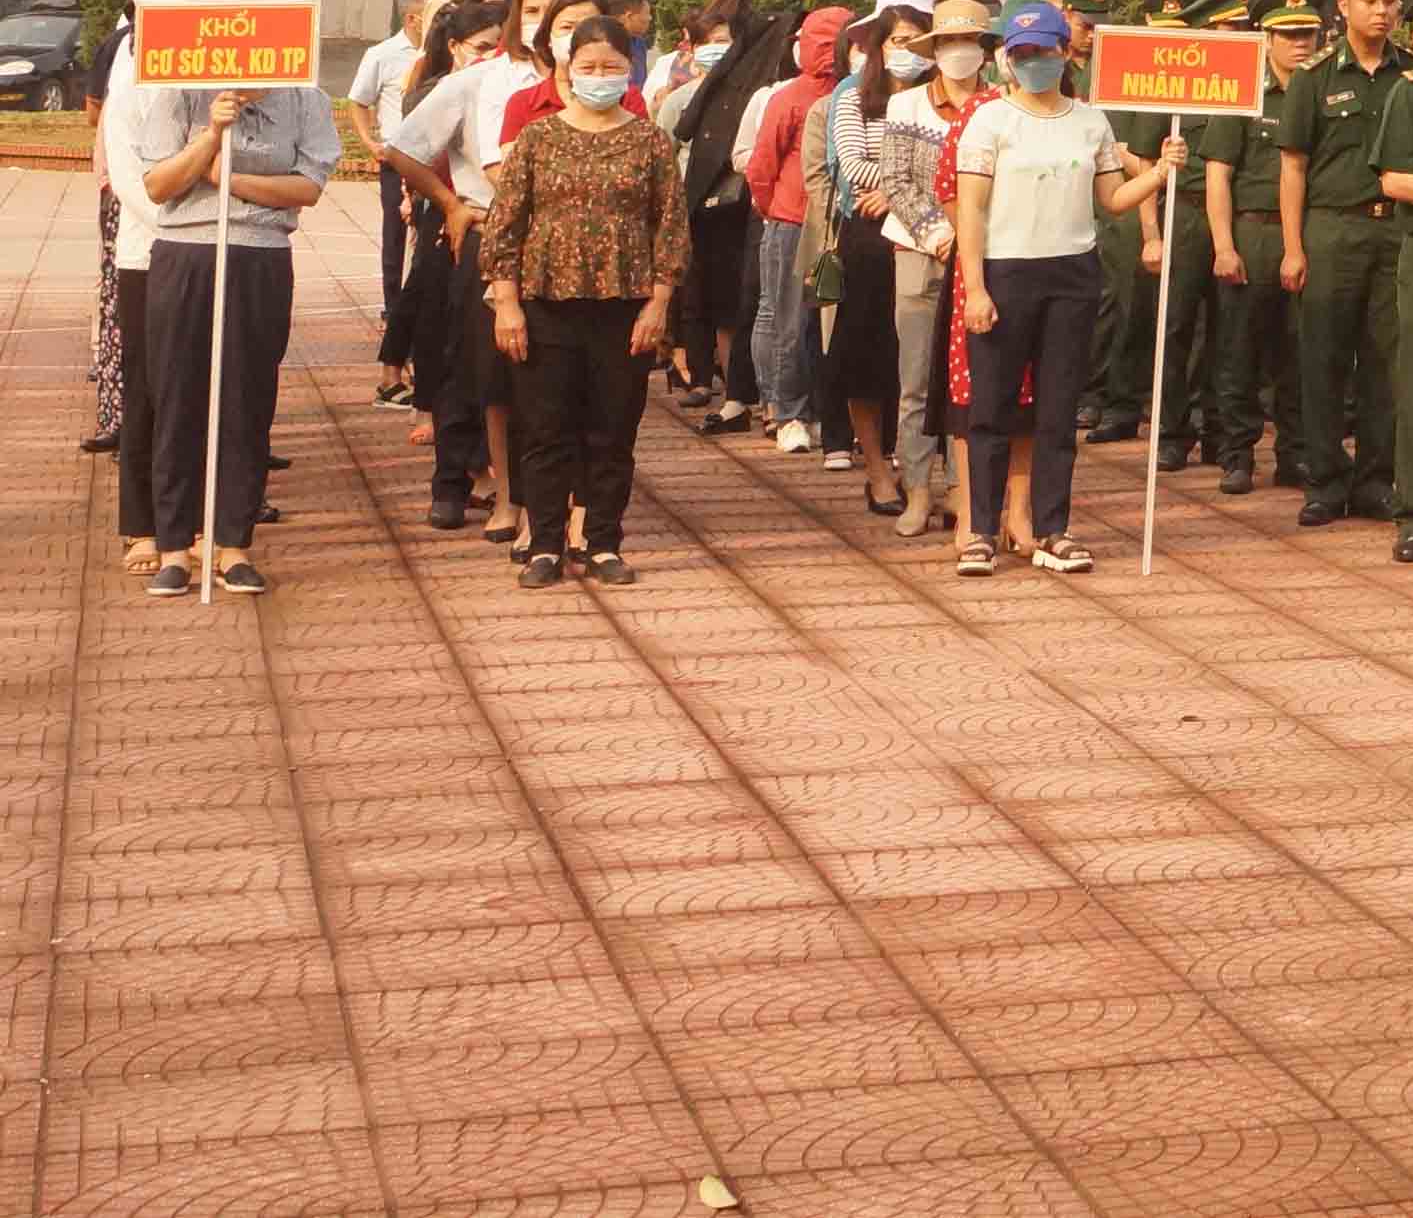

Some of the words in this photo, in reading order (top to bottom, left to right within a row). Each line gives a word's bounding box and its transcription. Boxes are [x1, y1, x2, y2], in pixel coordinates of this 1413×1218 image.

[199, 8, 256, 37] KHỐI
[145, 46, 175, 76] CƠ
[178, 37, 206, 76] SỞ
[210, 46, 243, 78] SX,
[248, 46, 276, 75] KD
[281, 46, 306, 76] TP
[1153, 42, 1207, 68] KHỐI
[1121, 70, 1185, 99] NHÂN
[1191, 73, 1239, 103] DÂN
